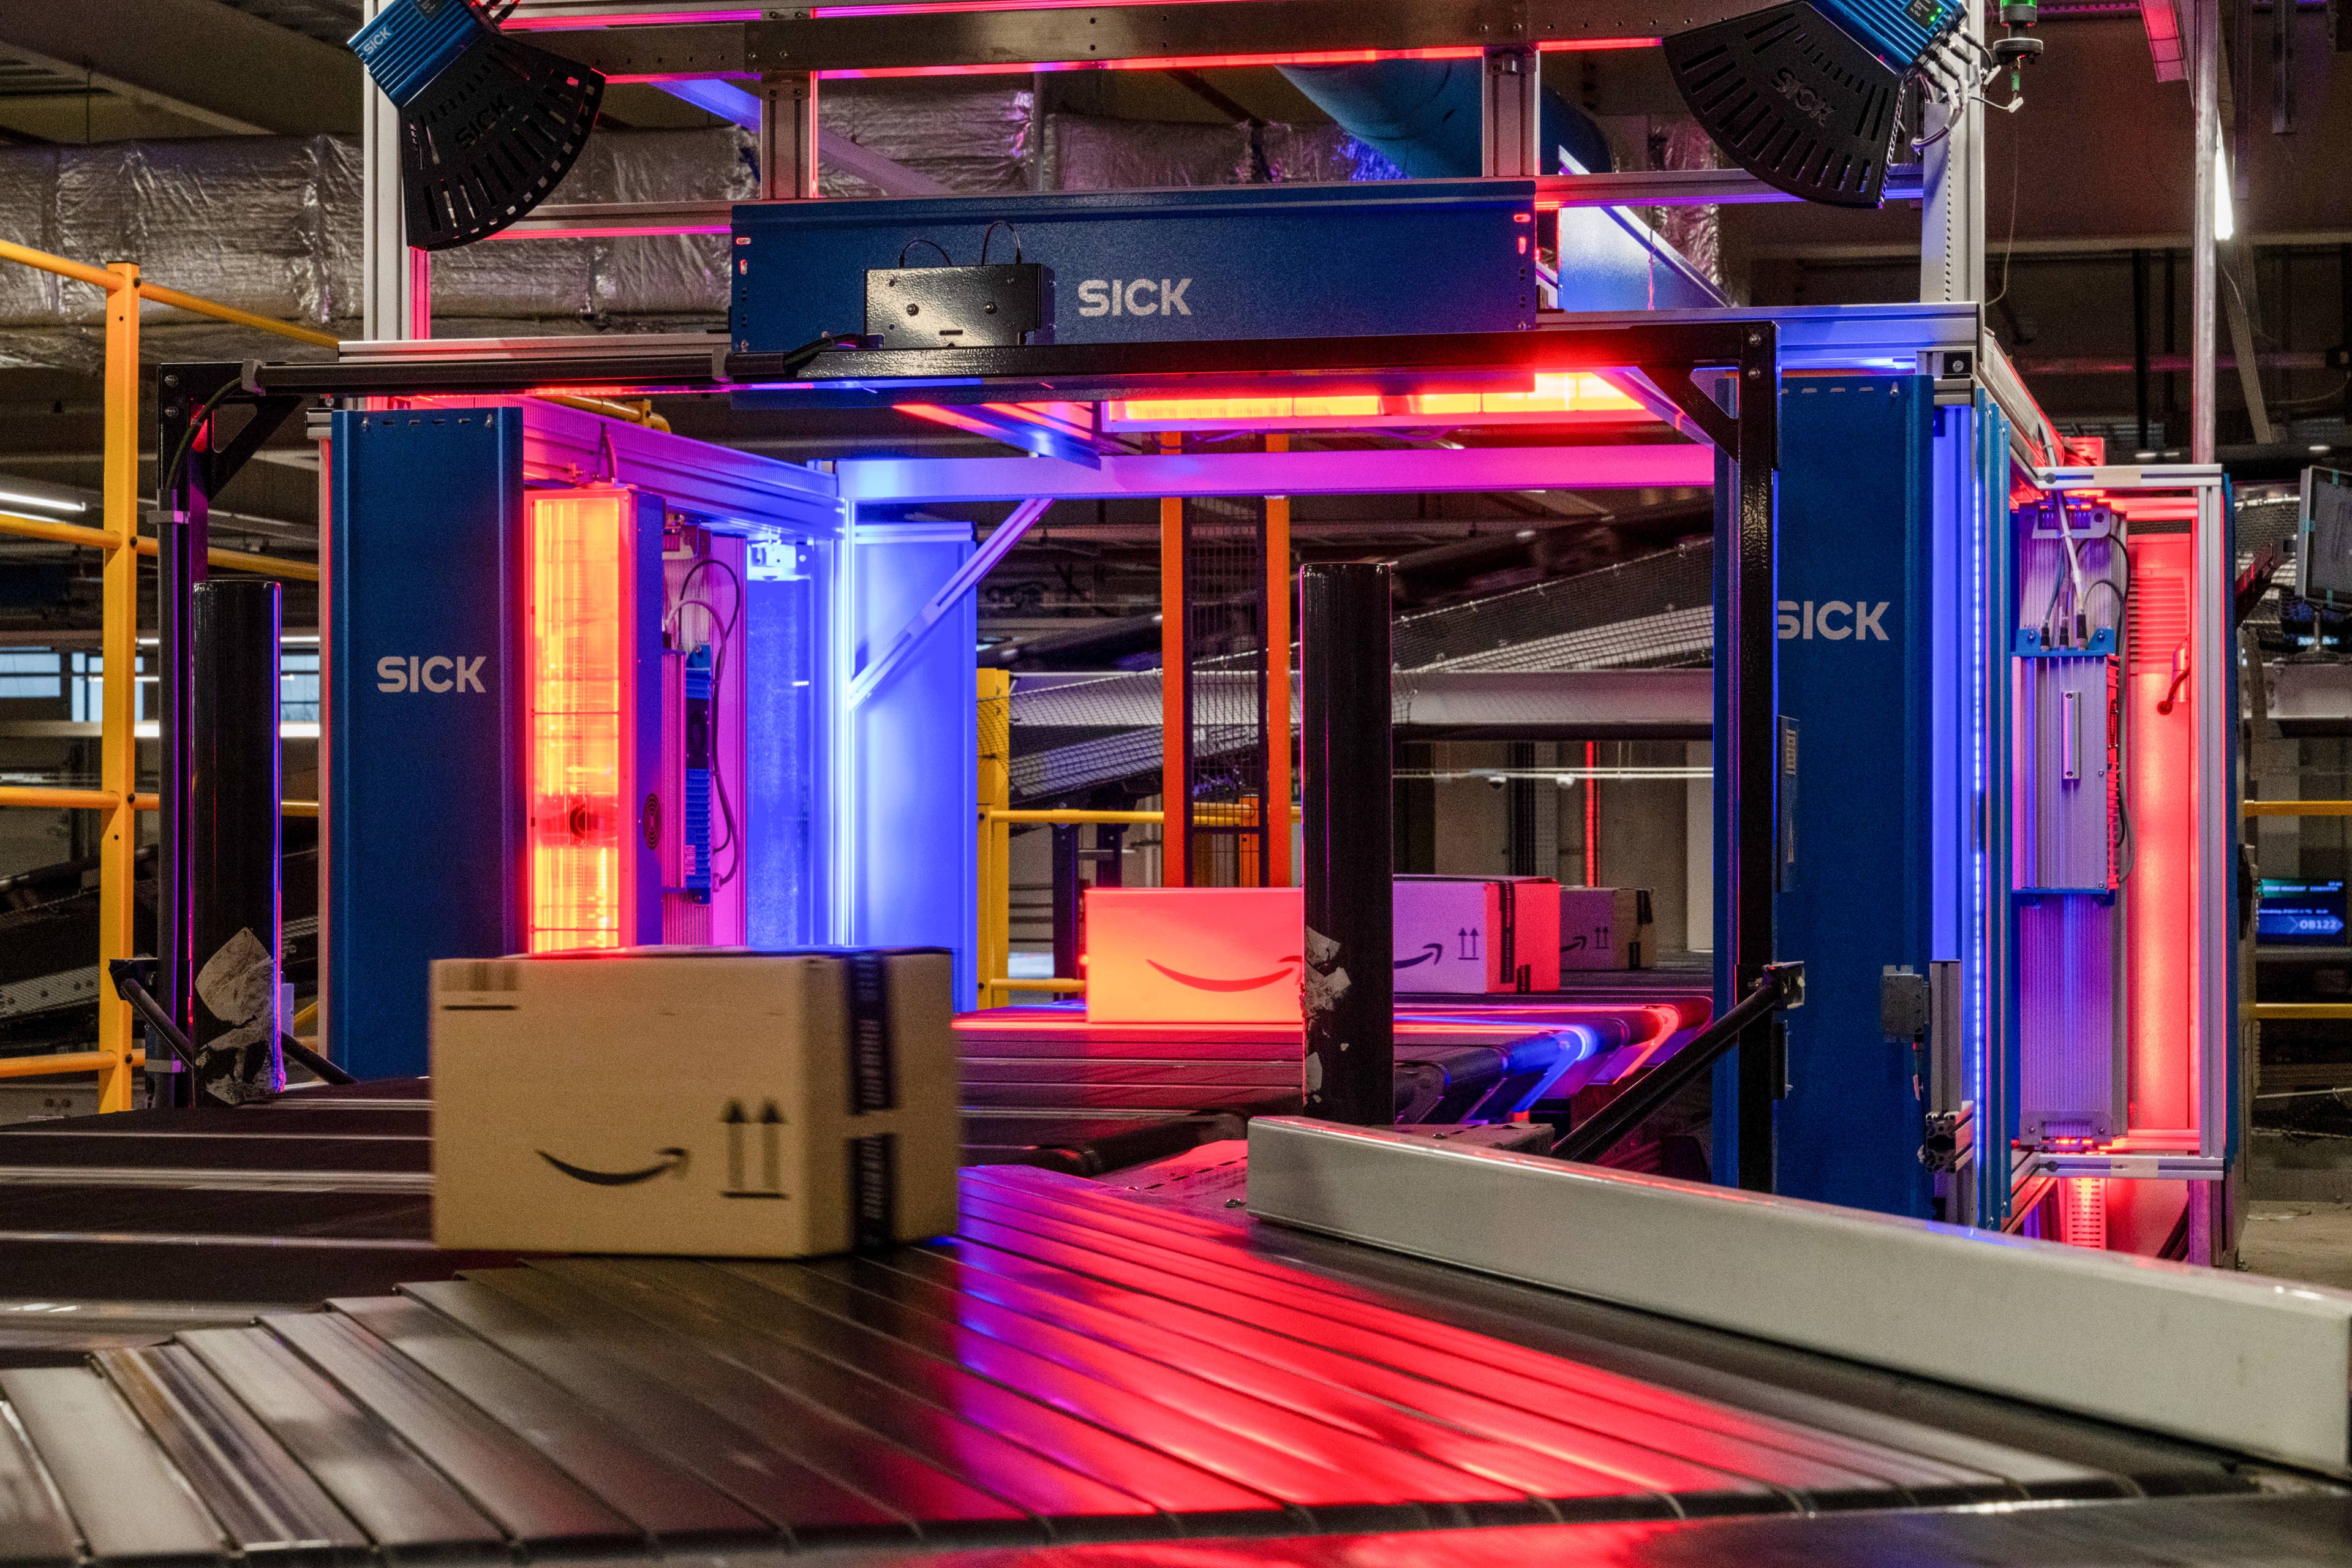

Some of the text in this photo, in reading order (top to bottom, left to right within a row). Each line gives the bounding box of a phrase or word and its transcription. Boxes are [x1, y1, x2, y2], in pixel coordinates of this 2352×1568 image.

[363, 26, 392, 56] SICK
[1770, 67, 1838, 127] SICK
[1078, 278, 1193, 317] SICK
[1777, 600, 1890, 641] SICK
[377, 655, 486, 693] SICK
